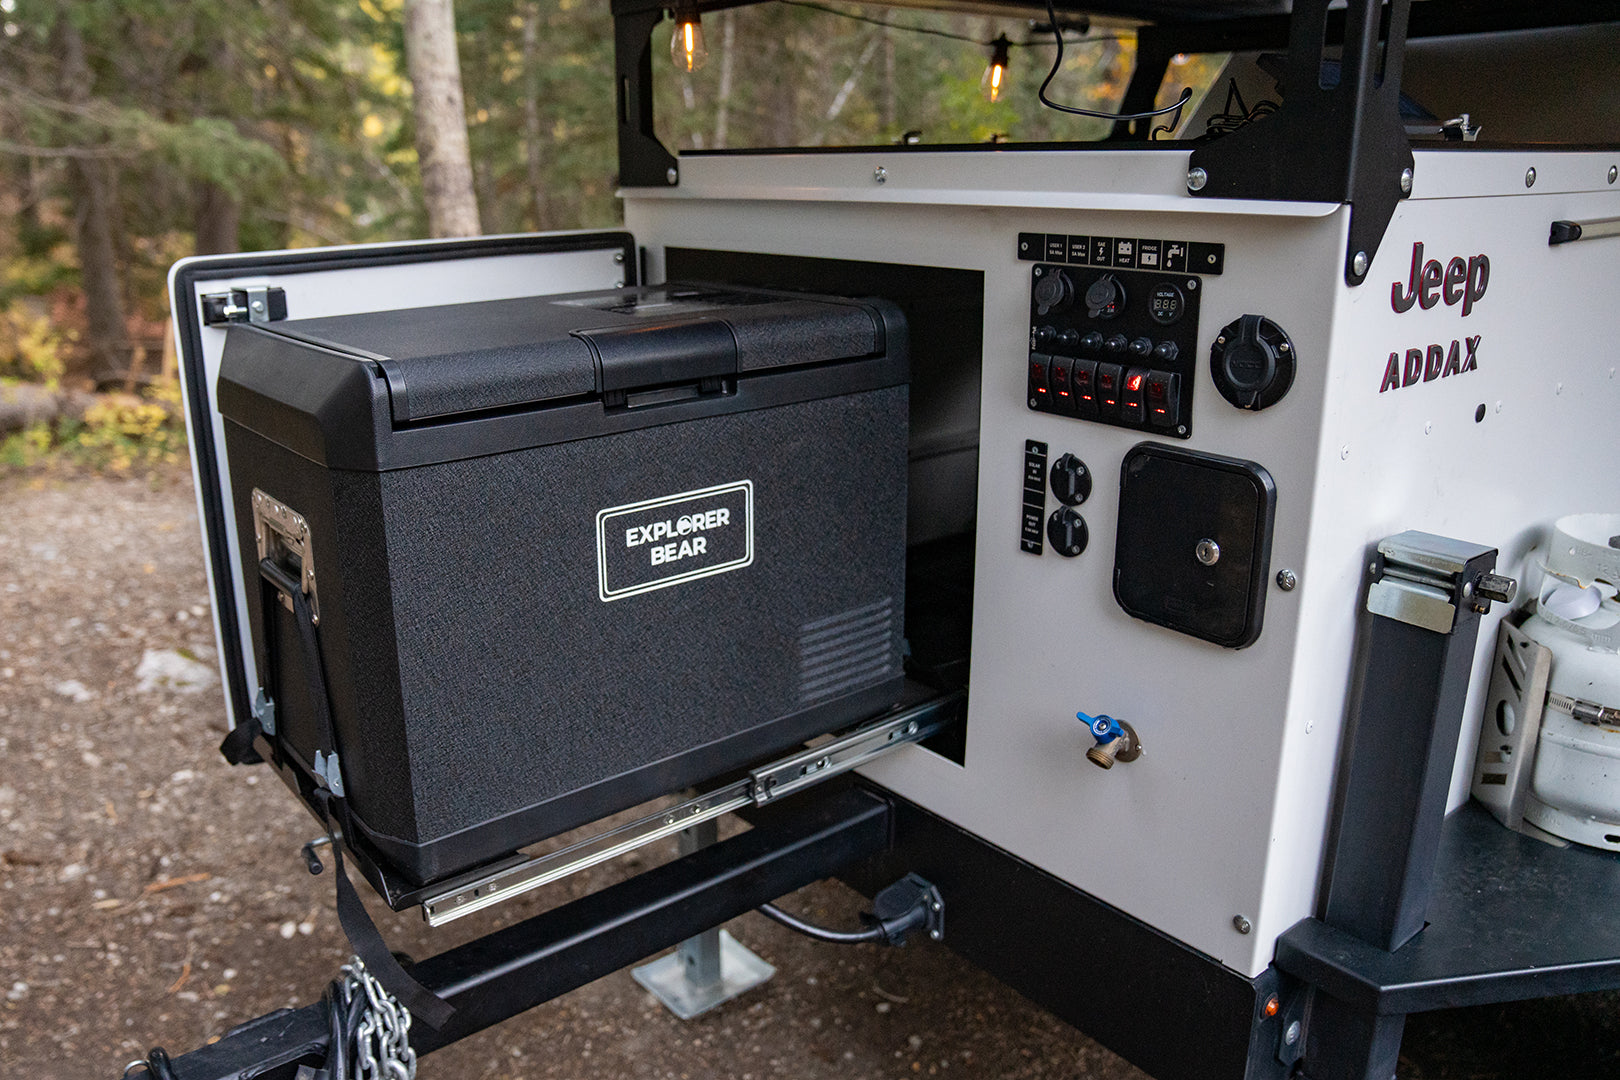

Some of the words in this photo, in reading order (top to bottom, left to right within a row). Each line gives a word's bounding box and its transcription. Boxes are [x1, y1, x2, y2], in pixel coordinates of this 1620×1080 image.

[1391, 241, 1491, 318] Jeep
[1379, 334, 1482, 394] ADDAX
[626, 507, 730, 548] EXPLORER
[650, 536, 708, 566] BEAR
